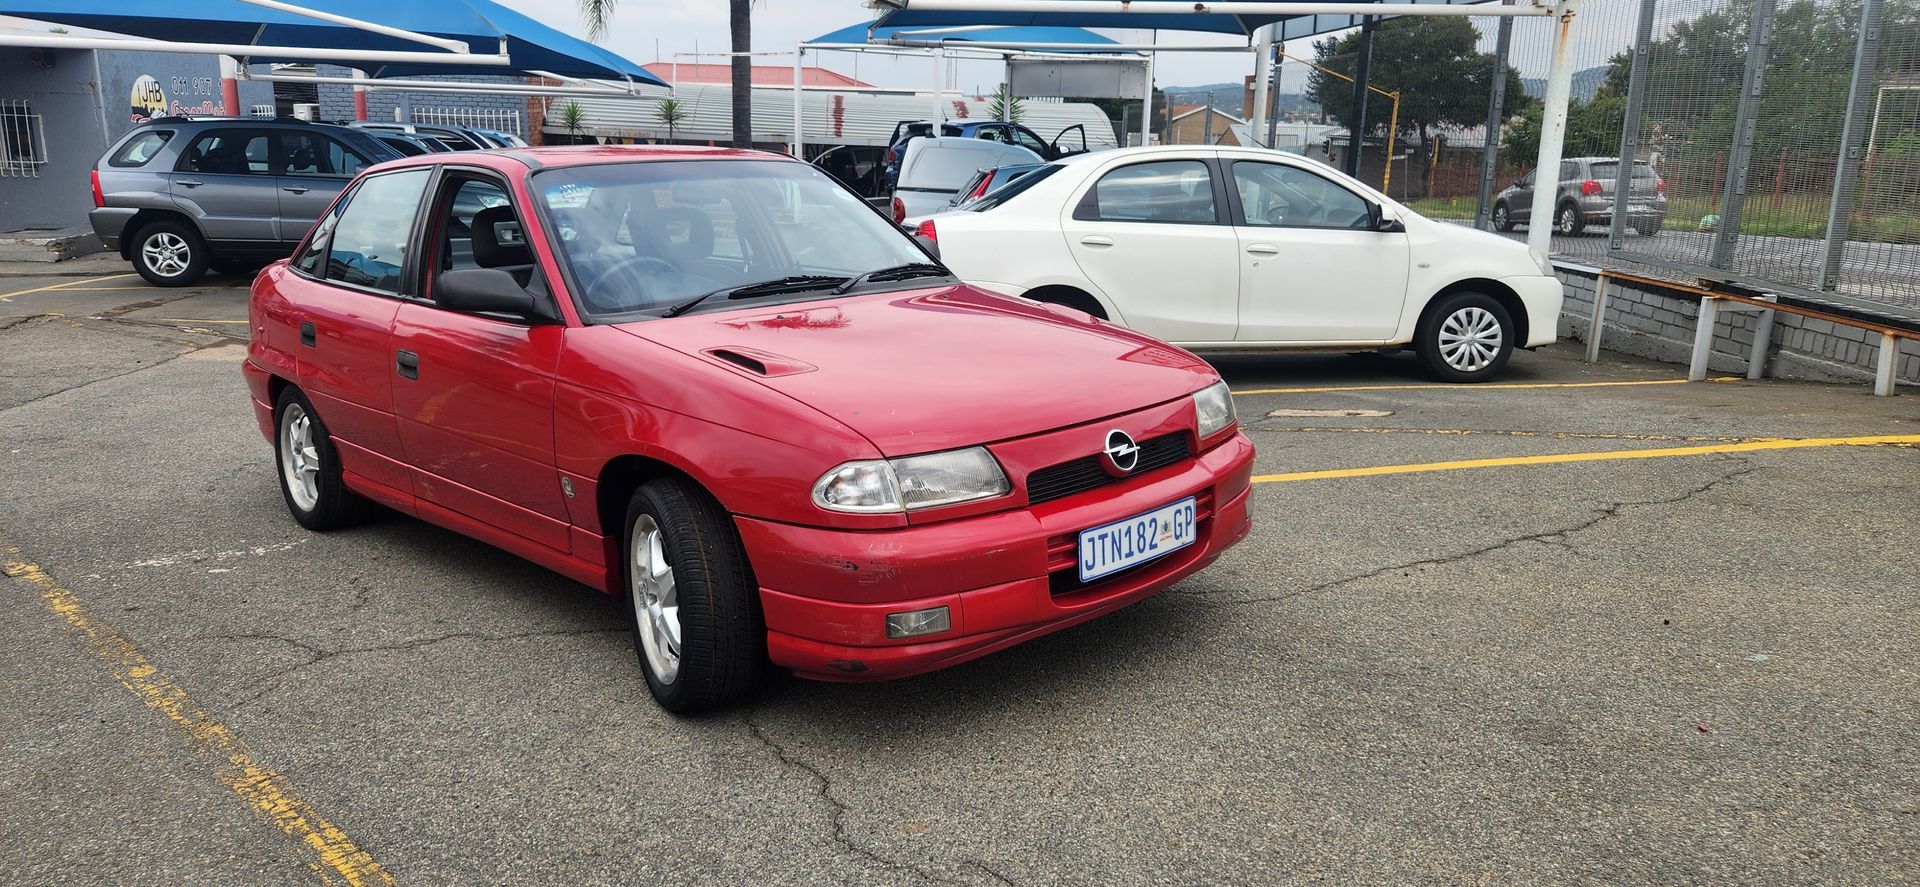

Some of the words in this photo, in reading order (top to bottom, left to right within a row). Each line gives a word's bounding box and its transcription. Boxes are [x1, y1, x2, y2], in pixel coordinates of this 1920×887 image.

[142, 81, 162, 103] JHB
[1085, 517, 1158, 571] JTN182
[1173, 505, 1193, 541] GP
